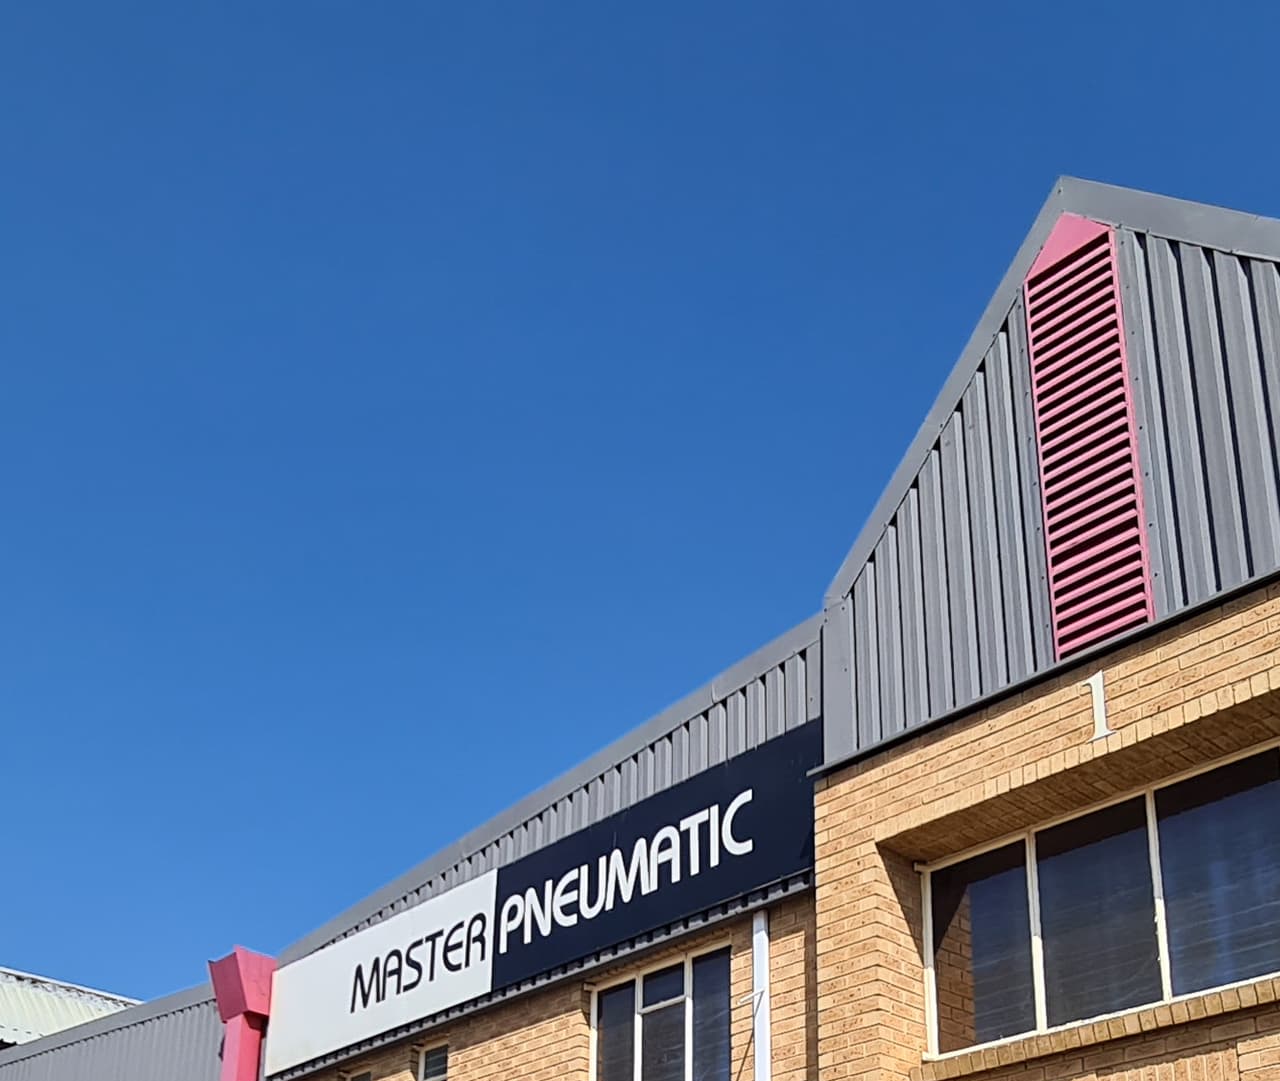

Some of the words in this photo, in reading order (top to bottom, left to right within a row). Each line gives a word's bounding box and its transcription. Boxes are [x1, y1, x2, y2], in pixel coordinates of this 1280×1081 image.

[1082, 669, 1117, 744] 1
[350, 912, 487, 1013] MASTER
[499, 789, 753, 955] PNEUMATIC
